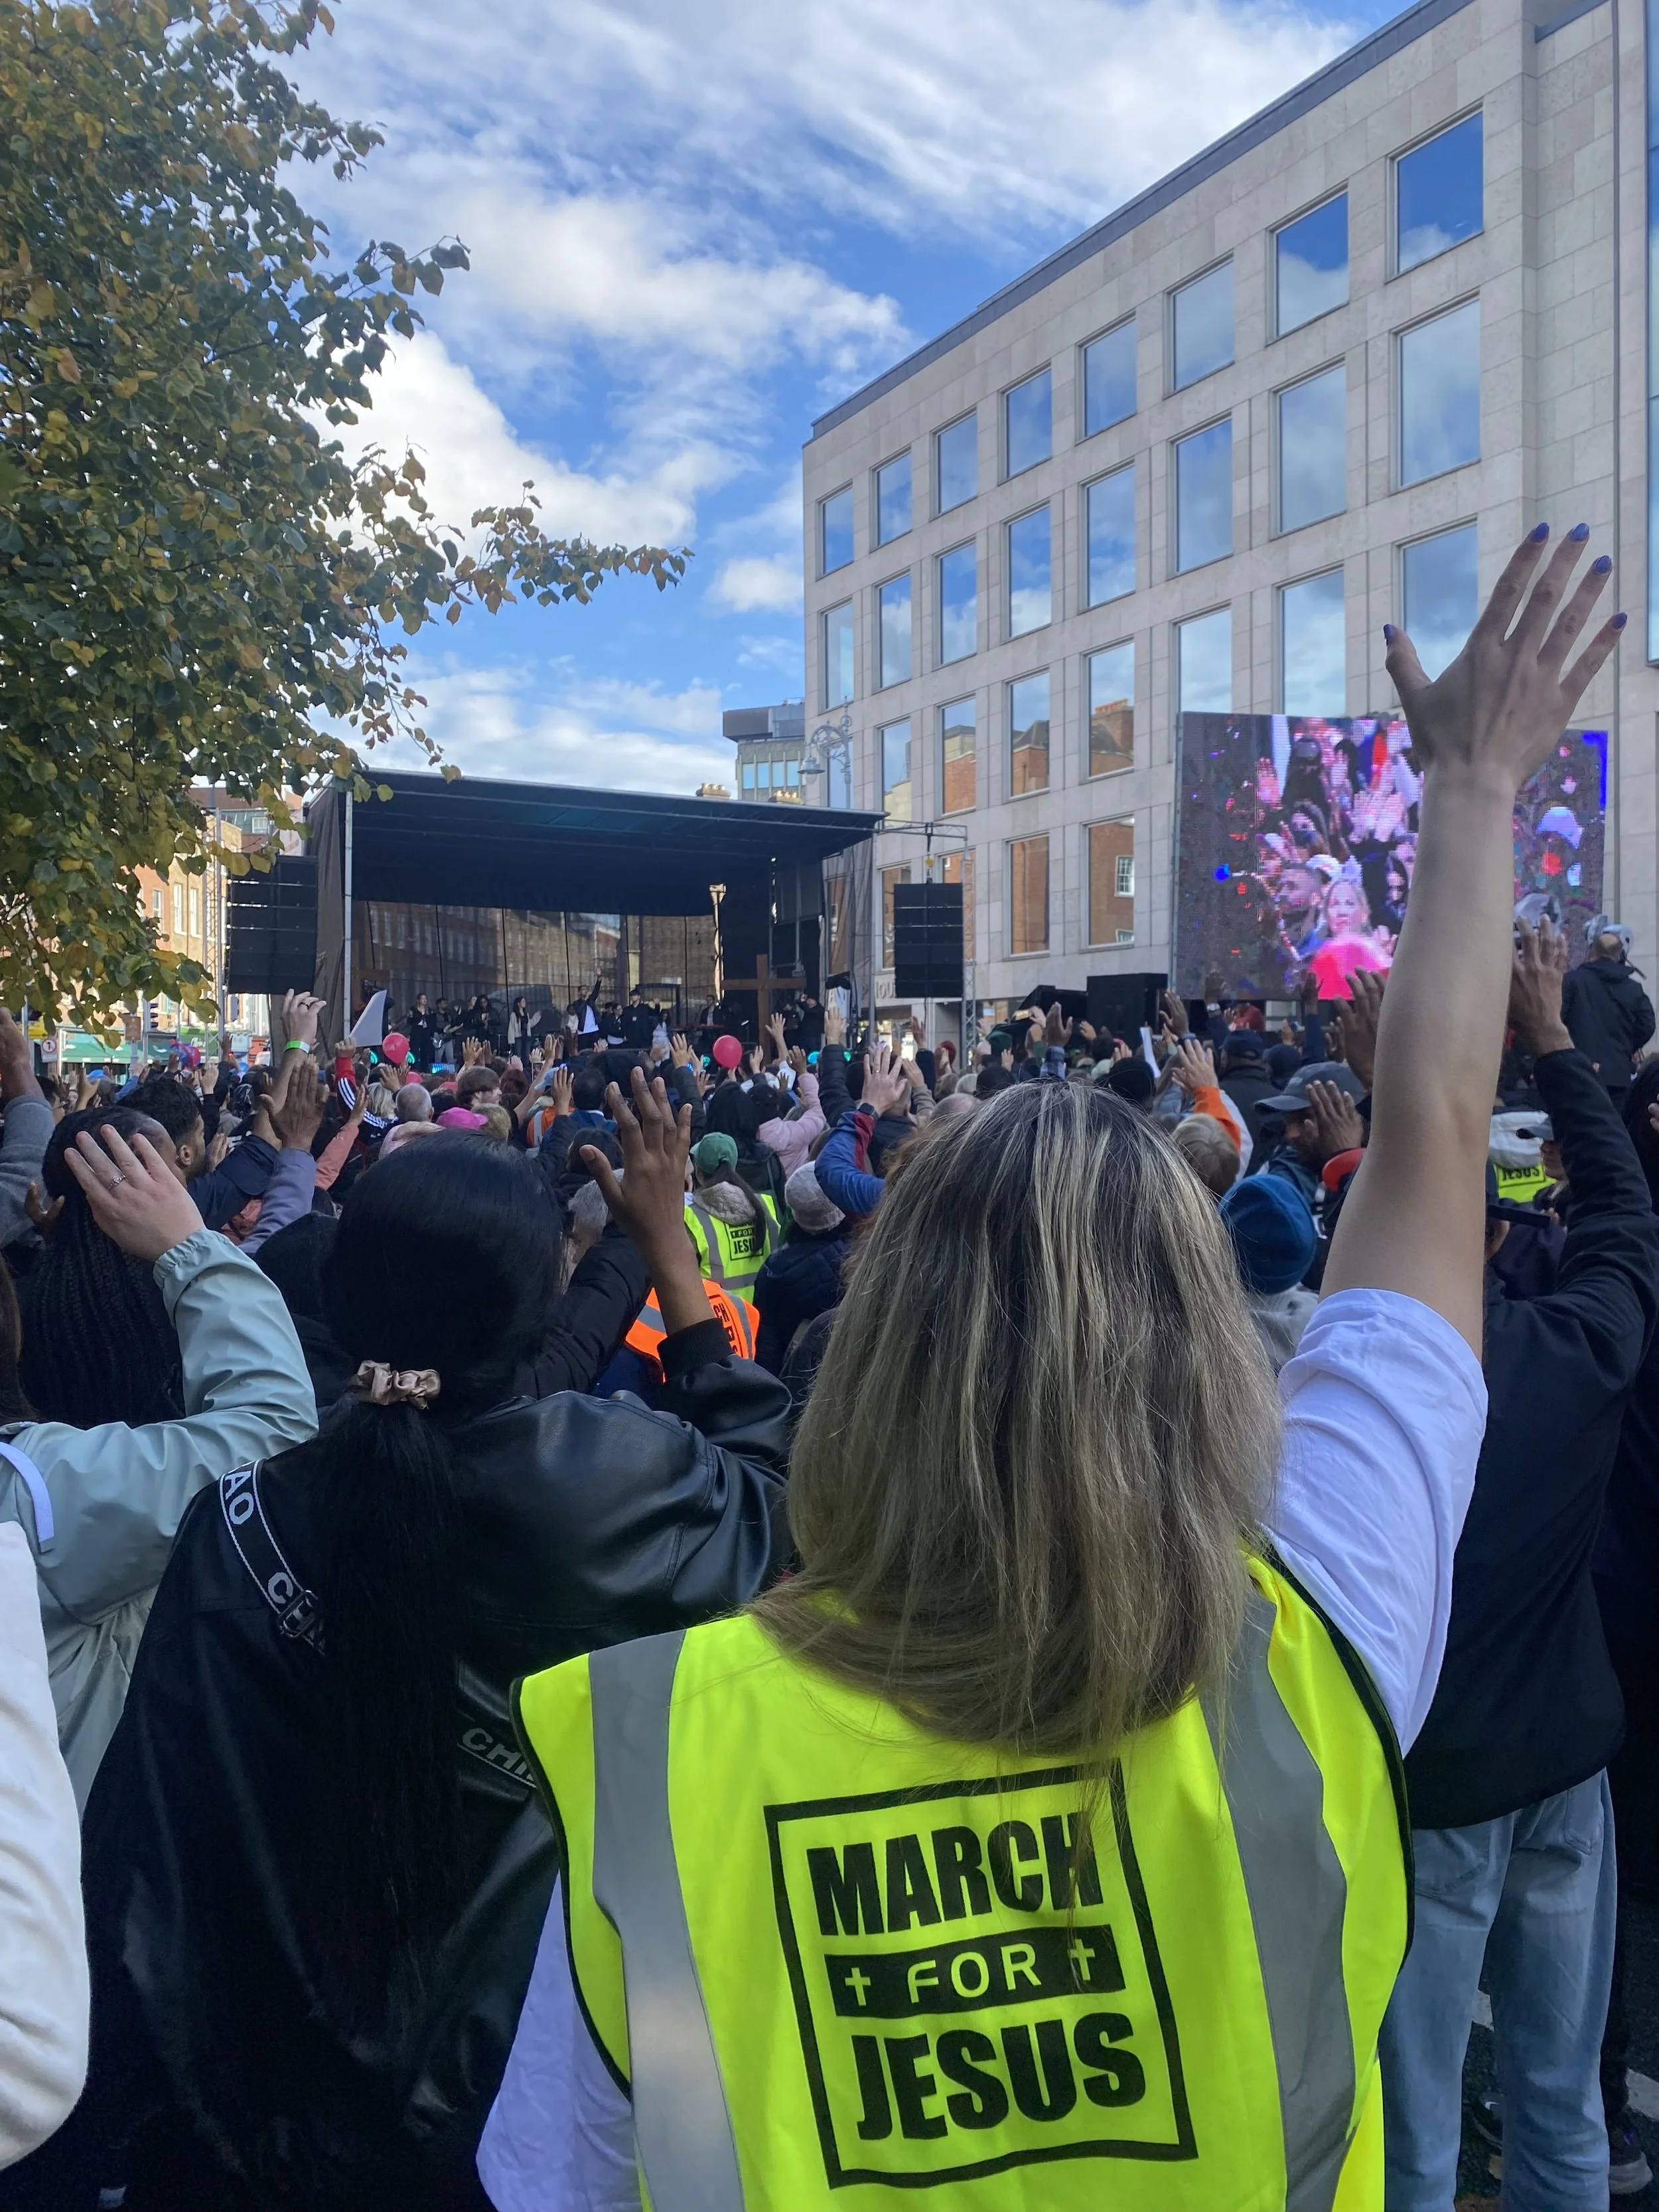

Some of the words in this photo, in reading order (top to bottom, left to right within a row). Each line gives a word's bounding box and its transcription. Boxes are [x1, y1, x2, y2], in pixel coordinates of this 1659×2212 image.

[733, 1238, 755, 1254] JESU
[738, 1228, 753, 1237] FOR
[462, 1728, 535, 1783] CHI
[806, 1810, 1104, 1937] MARCH
[906, 1943, 1042, 2004] FOR
[850, 2012, 1146, 2140] JESUS
